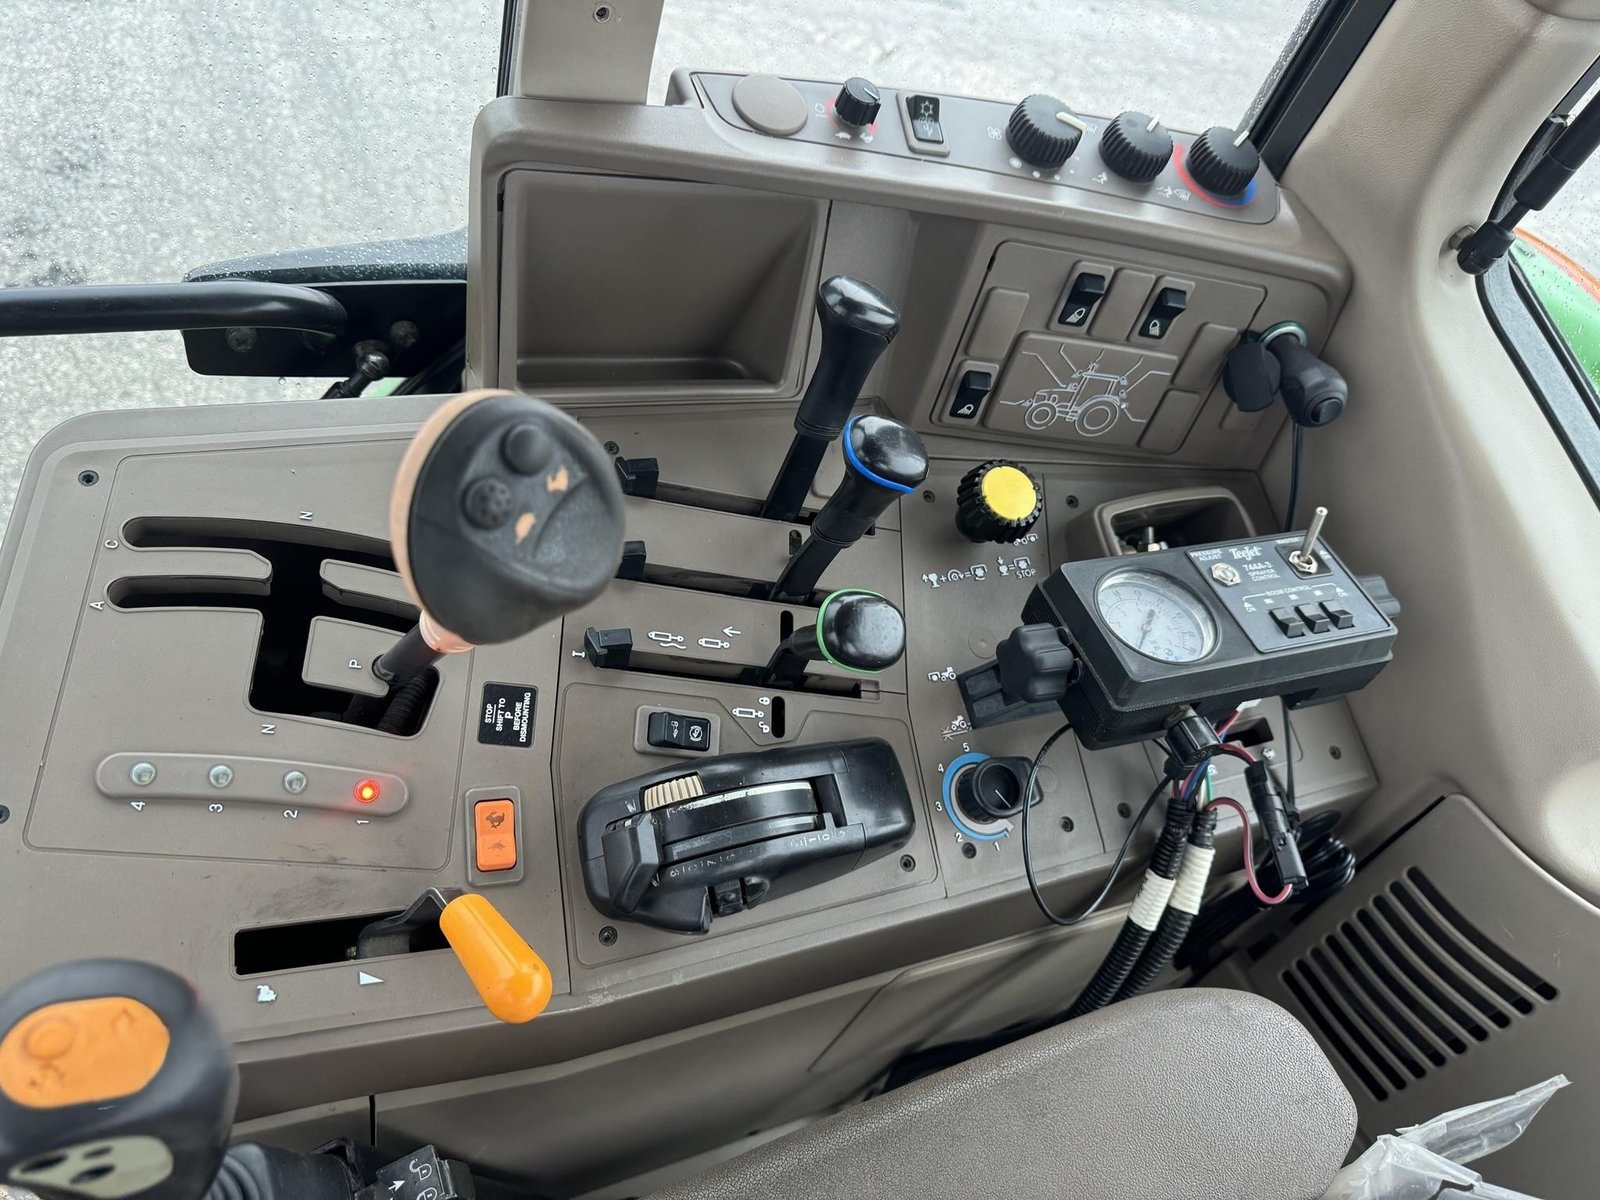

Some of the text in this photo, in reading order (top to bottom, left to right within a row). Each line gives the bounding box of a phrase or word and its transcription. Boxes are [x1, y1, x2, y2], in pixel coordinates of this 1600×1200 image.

[300, 510, 313, 520] N
[105, 539, 118, 550] C
[1228, 546, 1262, 561] TeeJet
[1015, 568, 1036, 579] STOP
[90, 600, 104, 611] A
[349, 659, 362, 669] P
[484, 703, 493, 724] STOP
[496, 697, 506, 732] SHIFT TO
[504, 711, 514, 719] P
[512, 702, 523, 731] BEFORE
[519, 692, 531, 743] DISMOUNTING
[260, 724, 275, 735] N
[962, 742, 970, 752] 5
[938, 763, 944, 773] 4
[130, 801, 146, 811] 4
[208, 803, 224, 813] 3
[935, 801, 943, 812] 3
[284, 809, 298, 819] 2
[955, 832, 963, 843] 2
[994, 841, 1000, 852] 1
